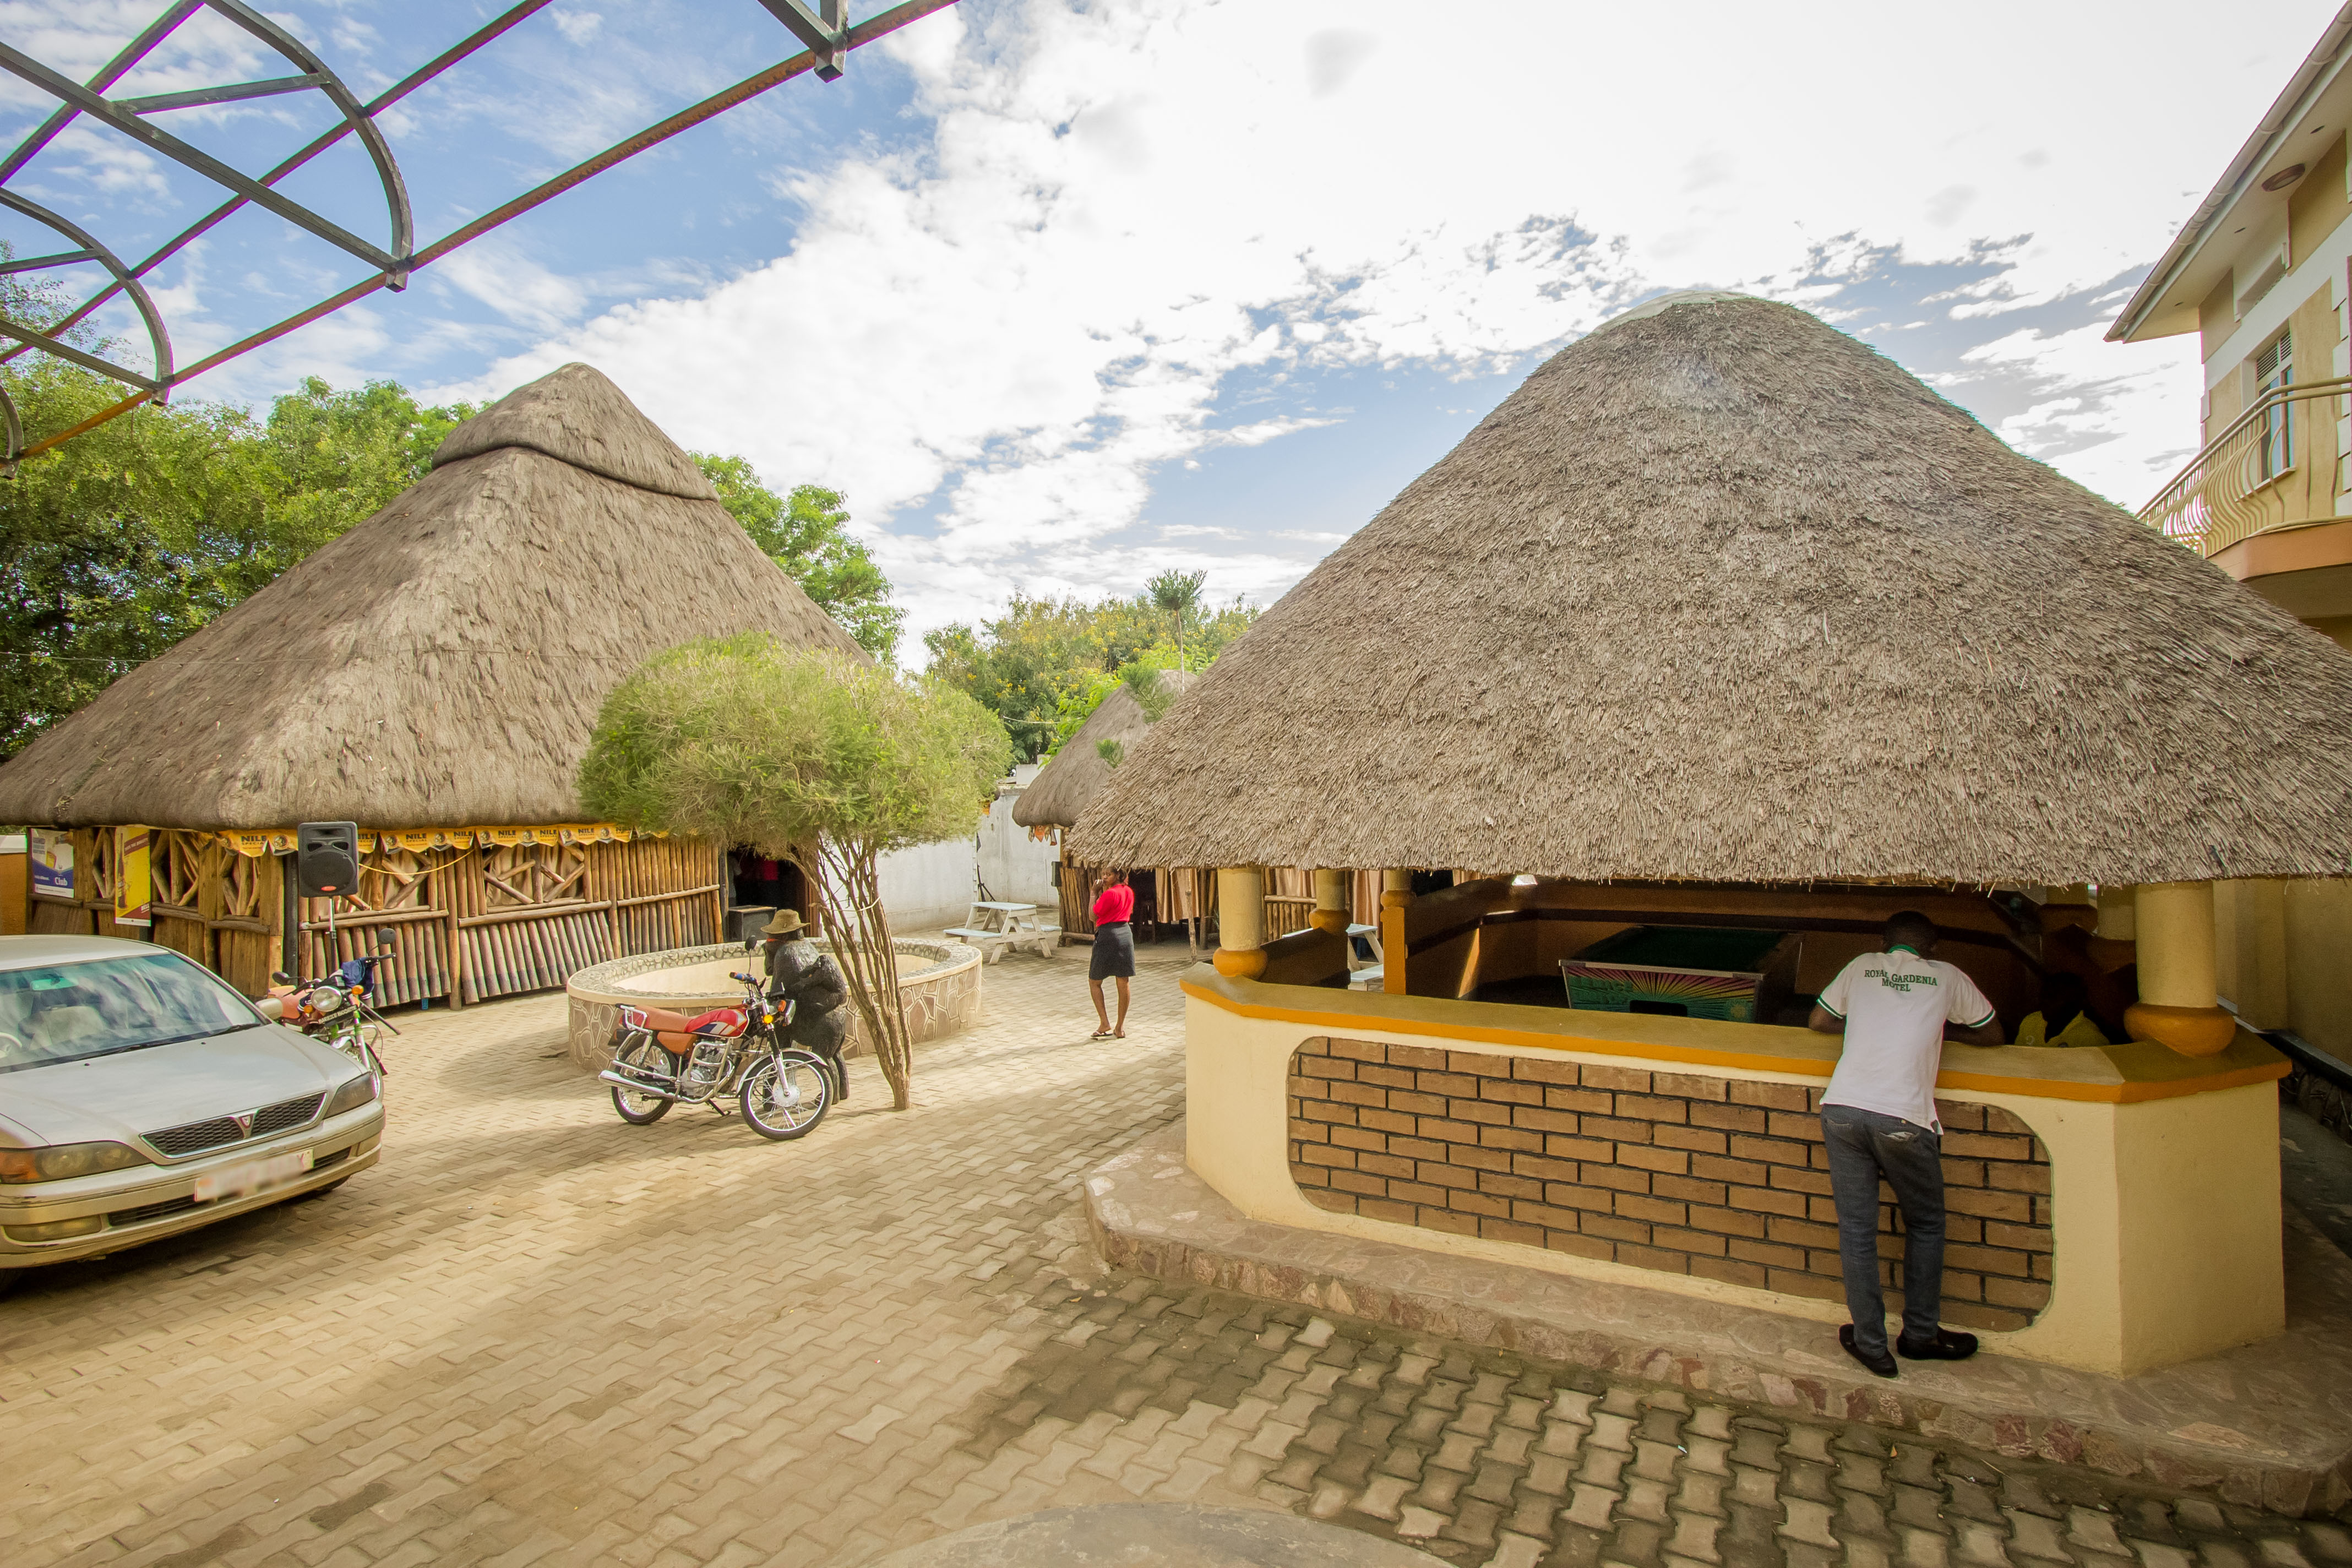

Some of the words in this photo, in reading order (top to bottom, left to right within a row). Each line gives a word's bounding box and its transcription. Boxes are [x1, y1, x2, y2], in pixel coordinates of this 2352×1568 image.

[55, 876, 68, 886] Club
[140, 903, 150, 911] BELL
[1864, 969, 1889, 979] ROYAL
[1891, 973, 1938, 986] GARDENIA
[1881, 978, 1911, 992] MOTEL
